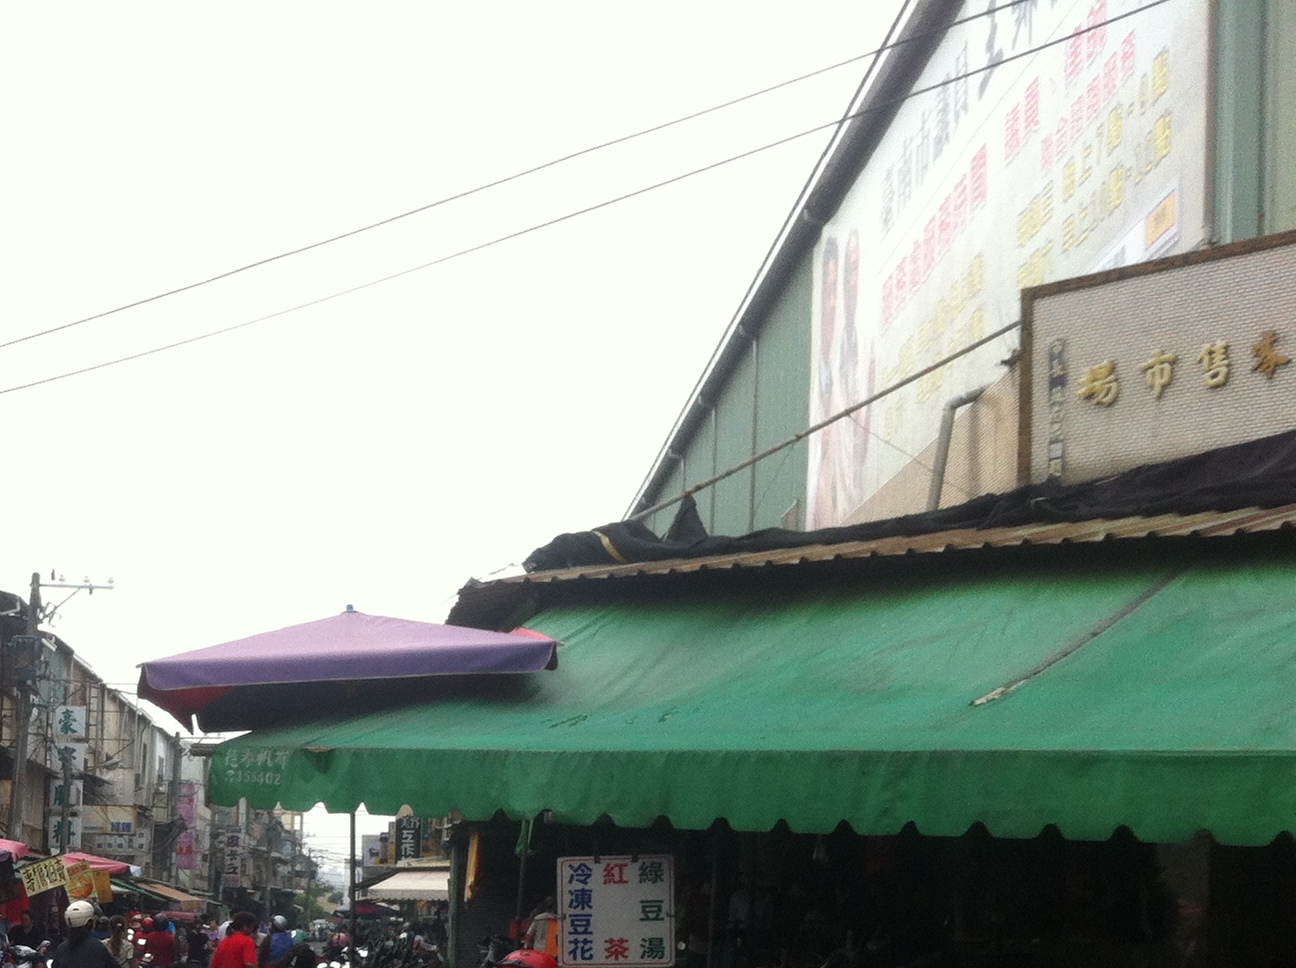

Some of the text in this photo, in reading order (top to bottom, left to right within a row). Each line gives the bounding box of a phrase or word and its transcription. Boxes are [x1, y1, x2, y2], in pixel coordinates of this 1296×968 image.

[567, 862, 594, 961] 冷凍豆花
[602, 862, 630, 961] 紅茶
[638, 861, 666, 960] 綠豆湯
